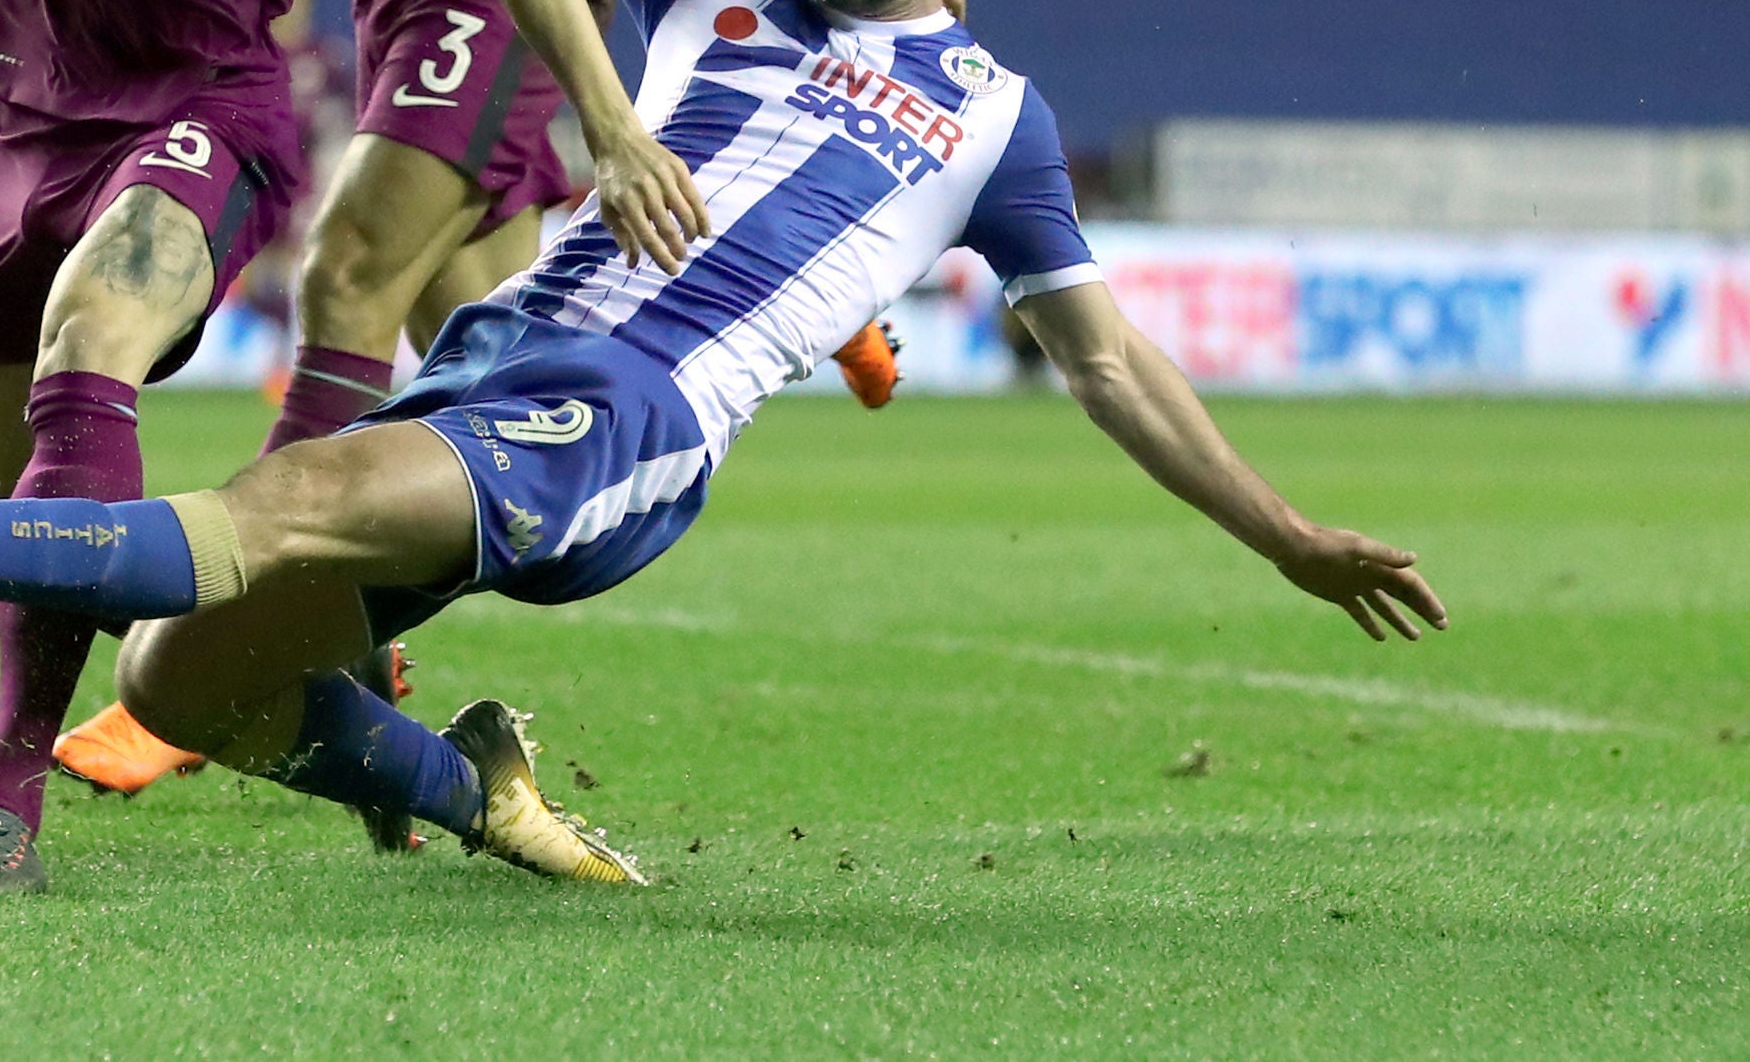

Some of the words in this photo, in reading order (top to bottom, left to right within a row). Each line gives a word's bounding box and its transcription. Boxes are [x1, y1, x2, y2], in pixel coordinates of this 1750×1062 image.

[419, 8, 487, 94] 3
[165, 120, 212, 168] 5
[784, 83, 944, 187] SPORT
[810, 57, 964, 162] INTER
[1112, 258, 1526, 378] TERSPORT
[494, 398, 594, 445] 9
[10, 520, 128, 549] LATICS
